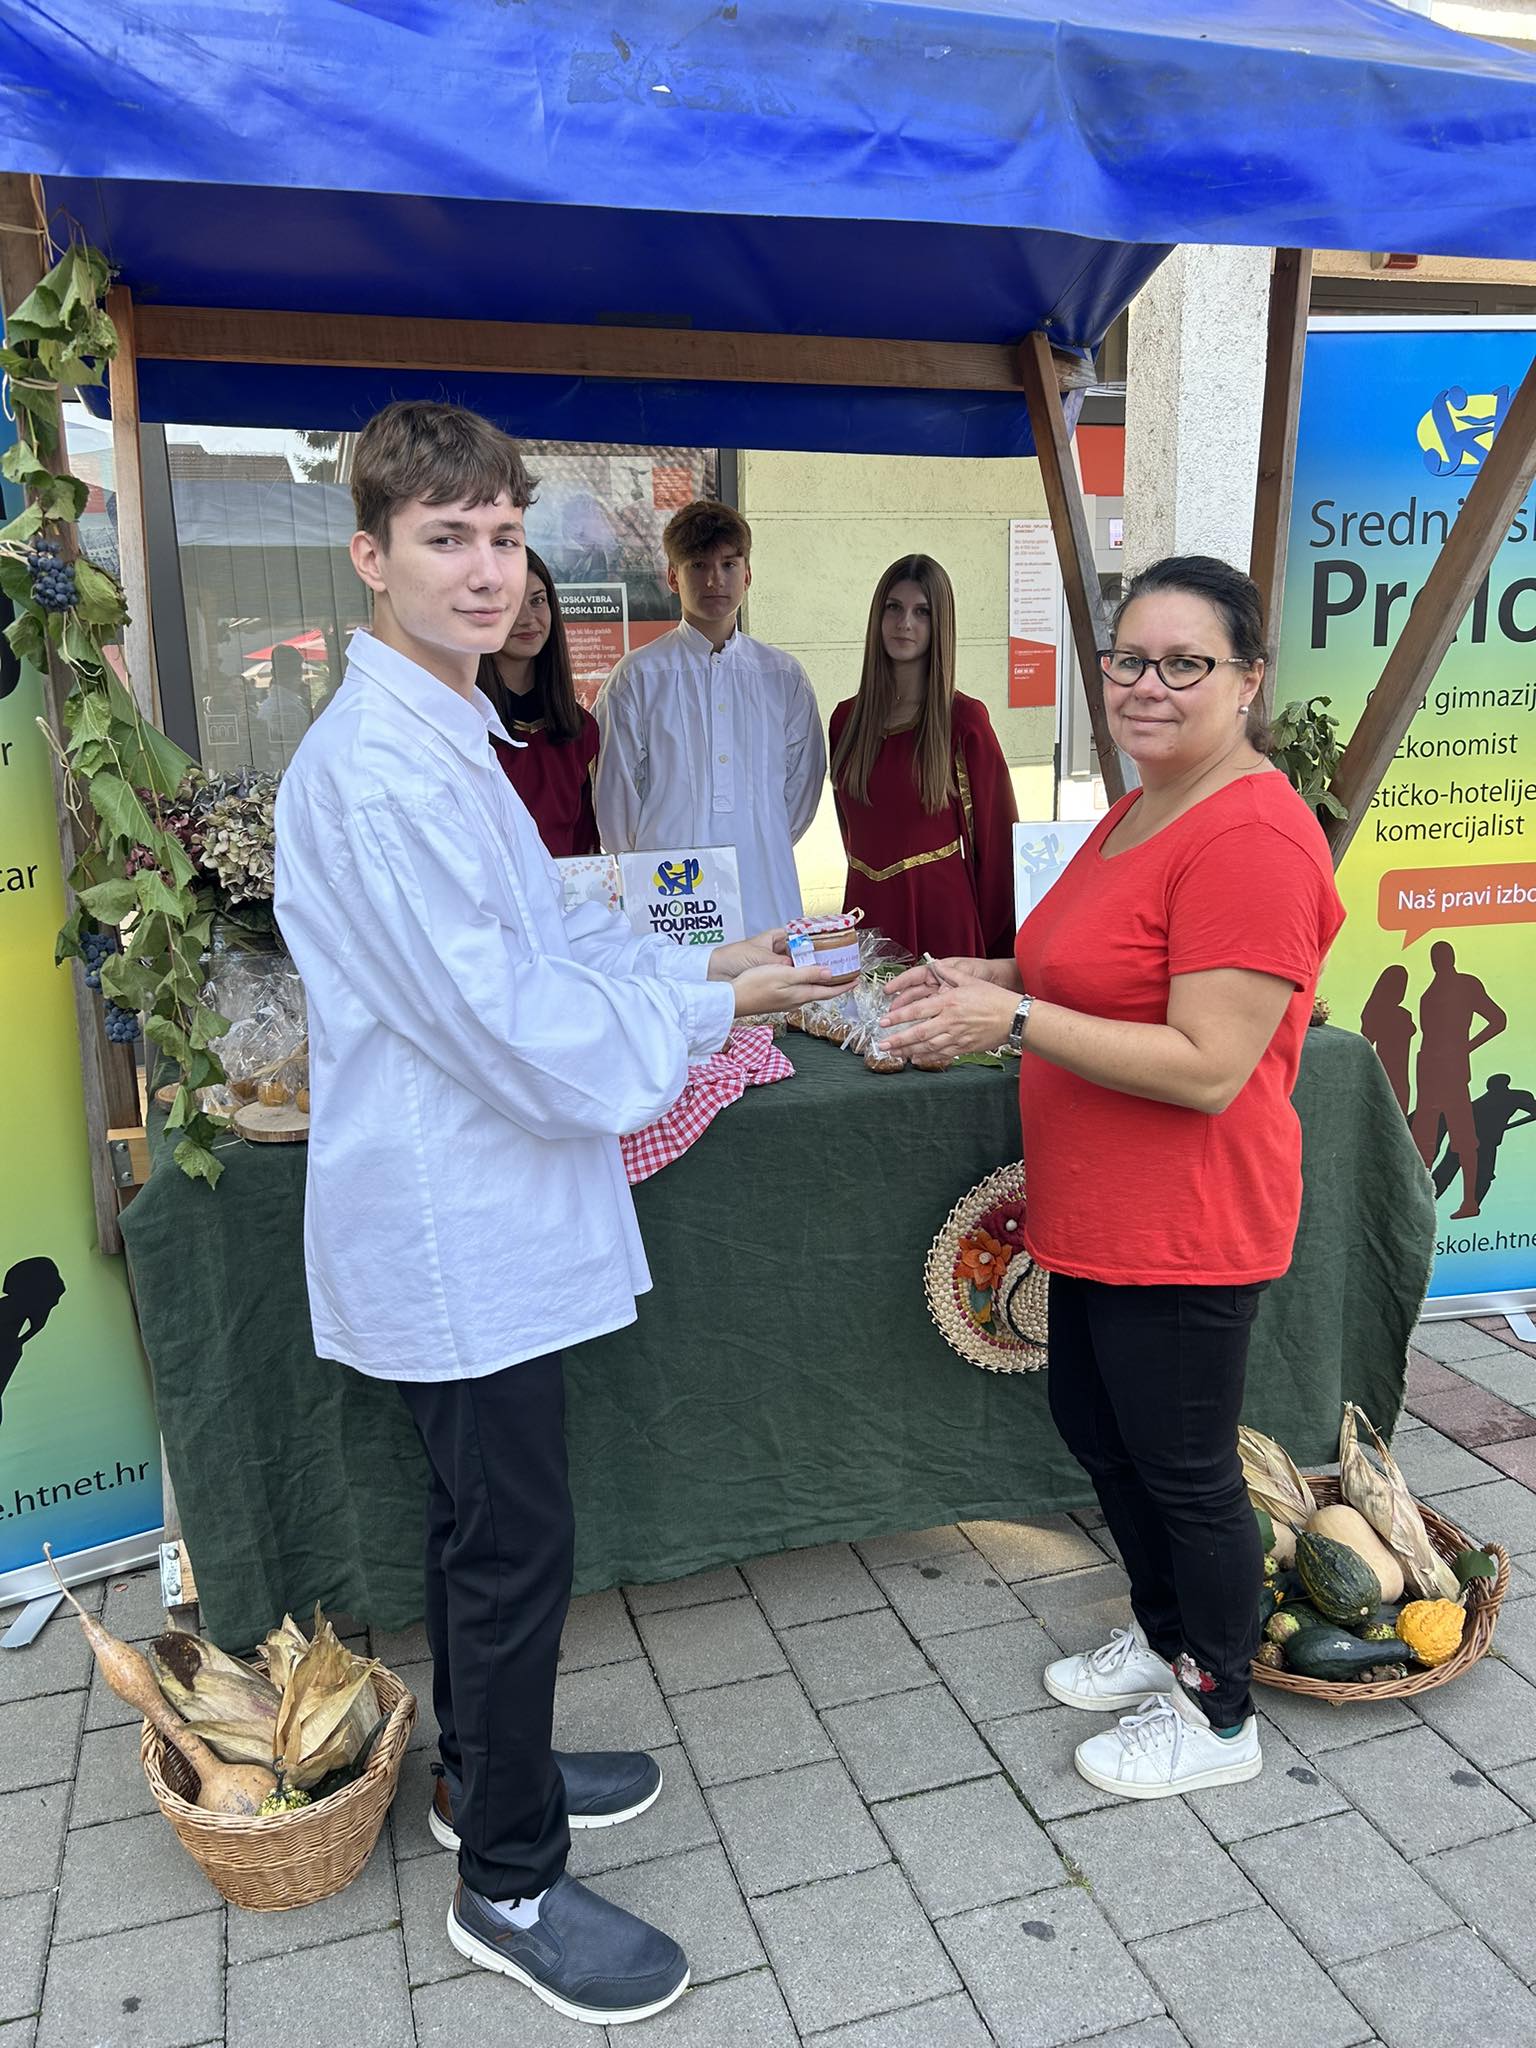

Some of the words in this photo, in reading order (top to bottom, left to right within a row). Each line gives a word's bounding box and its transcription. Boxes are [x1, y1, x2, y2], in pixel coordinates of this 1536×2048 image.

[586, 595, 612, 603] VIBRA
[1311, 558, 1536, 649] Prlo
[593, 605, 619, 614] IDILA?
[1376, 813, 1525, 844] komercijalist
[1398, 888, 1436, 910] Naš
[1441, 885, 1491, 912] pravi
[648, 900, 717, 917] WORLD
[650, 914, 723, 933] TOURISM
[688, 929, 724, 945] 2023
